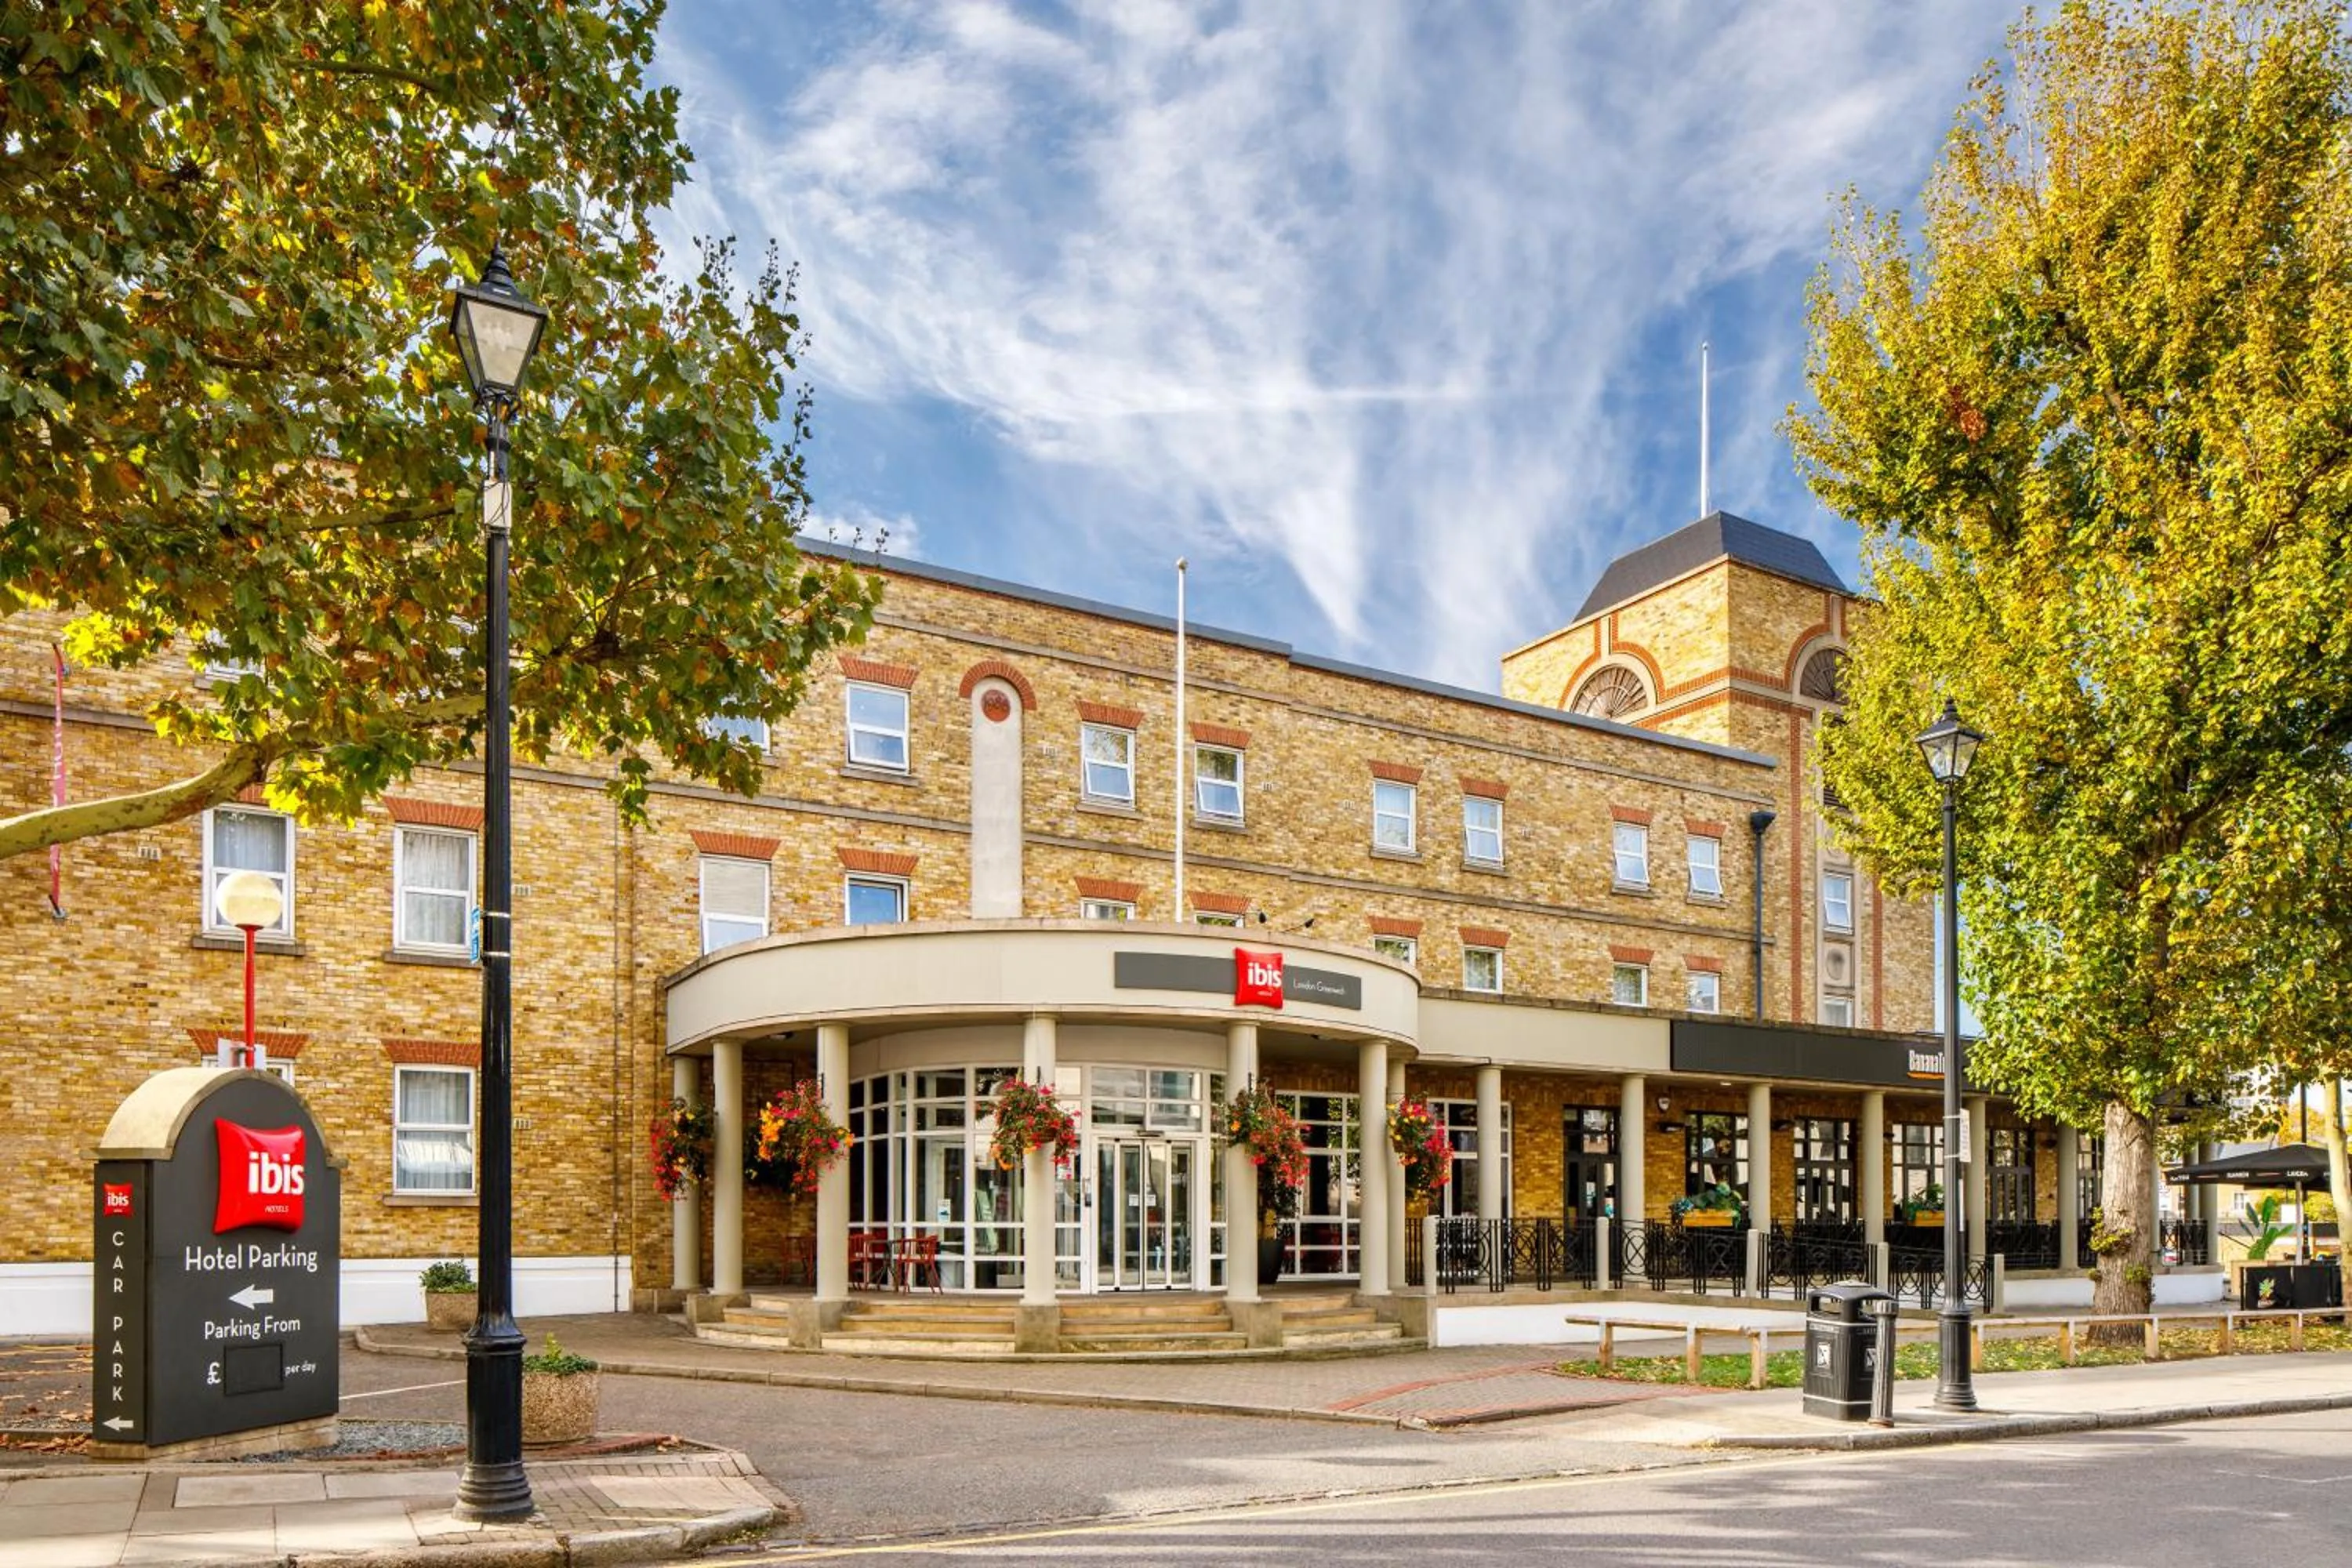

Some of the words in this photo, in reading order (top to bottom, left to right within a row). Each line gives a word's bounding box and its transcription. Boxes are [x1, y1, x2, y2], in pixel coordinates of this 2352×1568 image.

[1247, 961, 1282, 988] ibis
[1909, 1050, 1945, 1073] BananaT
[248, 1150, 305, 1196] ibis
[107, 1191, 129, 1207] ibis
[111, 1232, 125, 1294] CAR
[185, 1243, 242, 1271] Hotel
[248, 1243, 318, 1272] Parking
[204, 1318, 261, 1340] Parking
[263, 1315, 301, 1334] From
[111, 1316, 125, 1402] PARK
[284, 1366, 299, 1377] per
[301, 1359, 317, 1374] day
